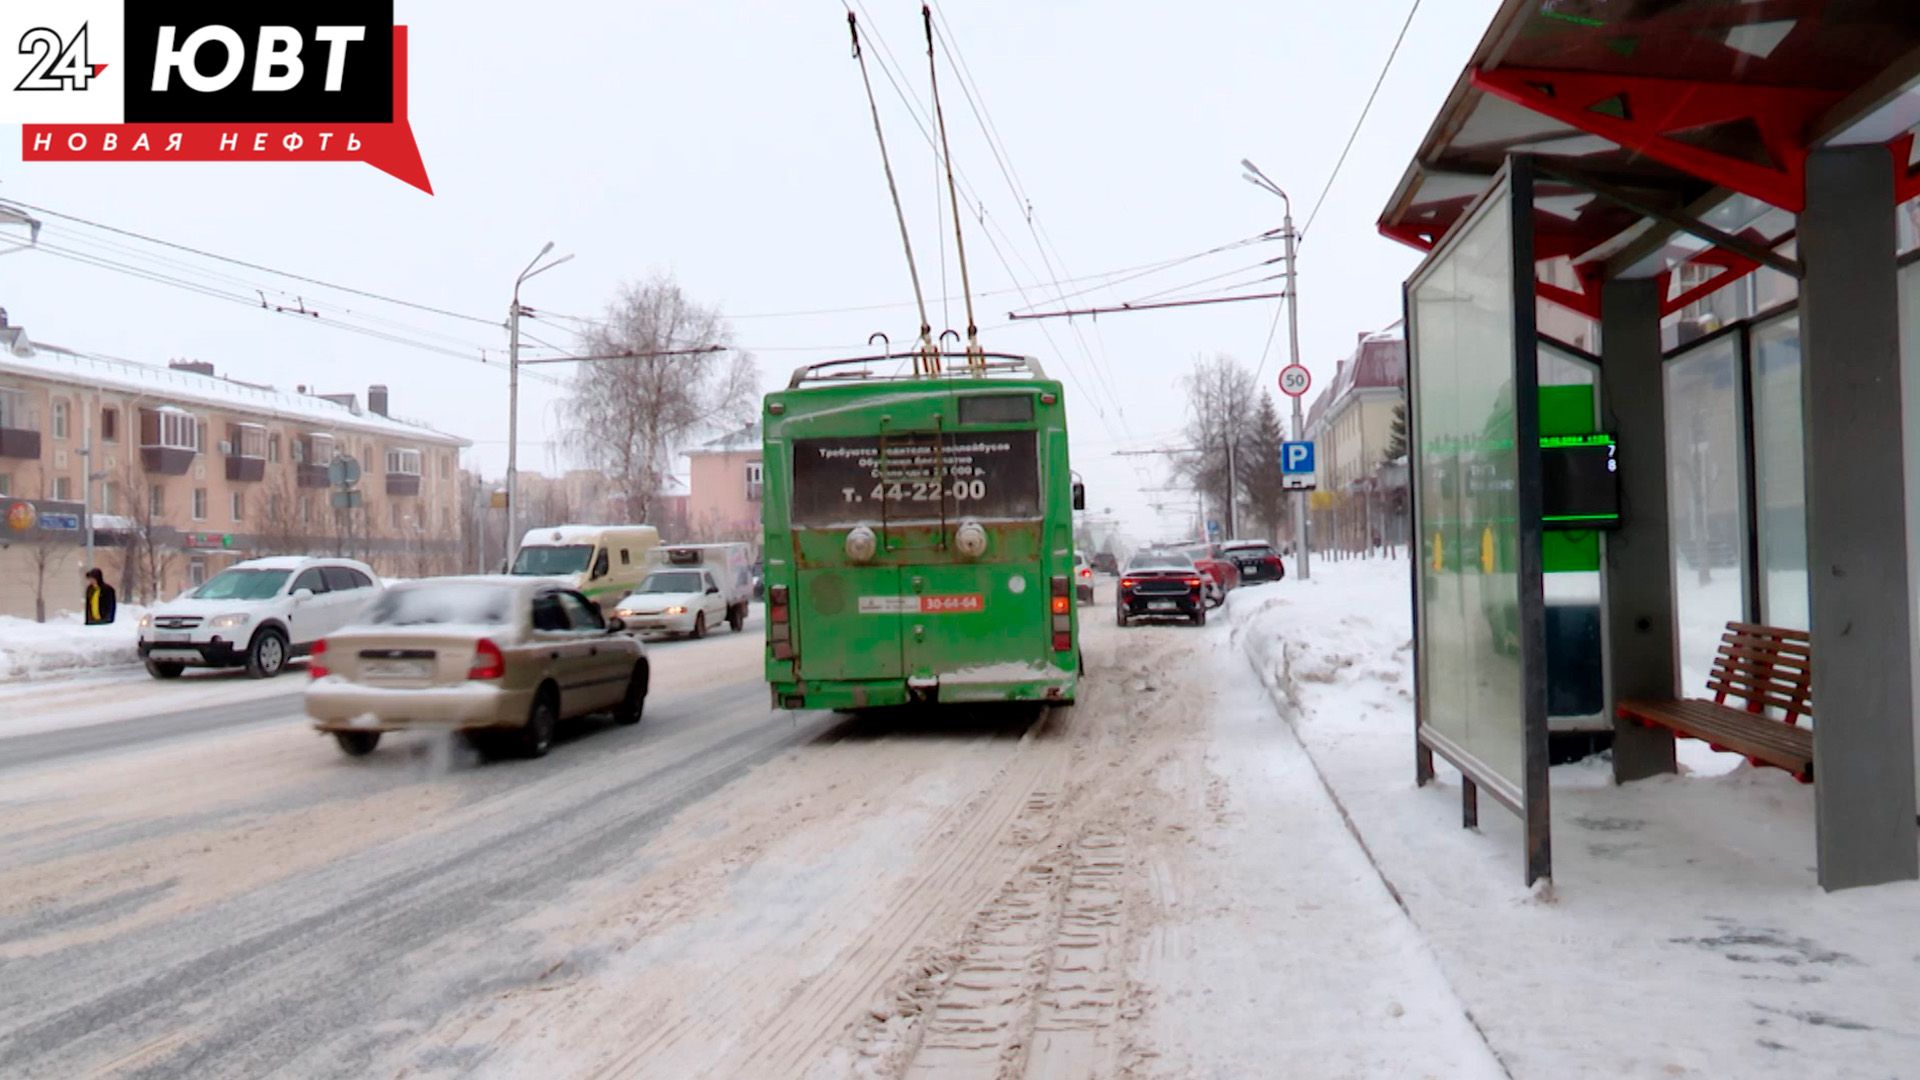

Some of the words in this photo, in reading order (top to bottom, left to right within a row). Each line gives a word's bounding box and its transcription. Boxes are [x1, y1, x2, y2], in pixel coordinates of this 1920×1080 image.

[1286, 374, 1305, 388] 50
[881, 445, 931, 457] одители
[858, 457, 912, 468] Обуение
[870, 479, 986, 501] 44-22-00
